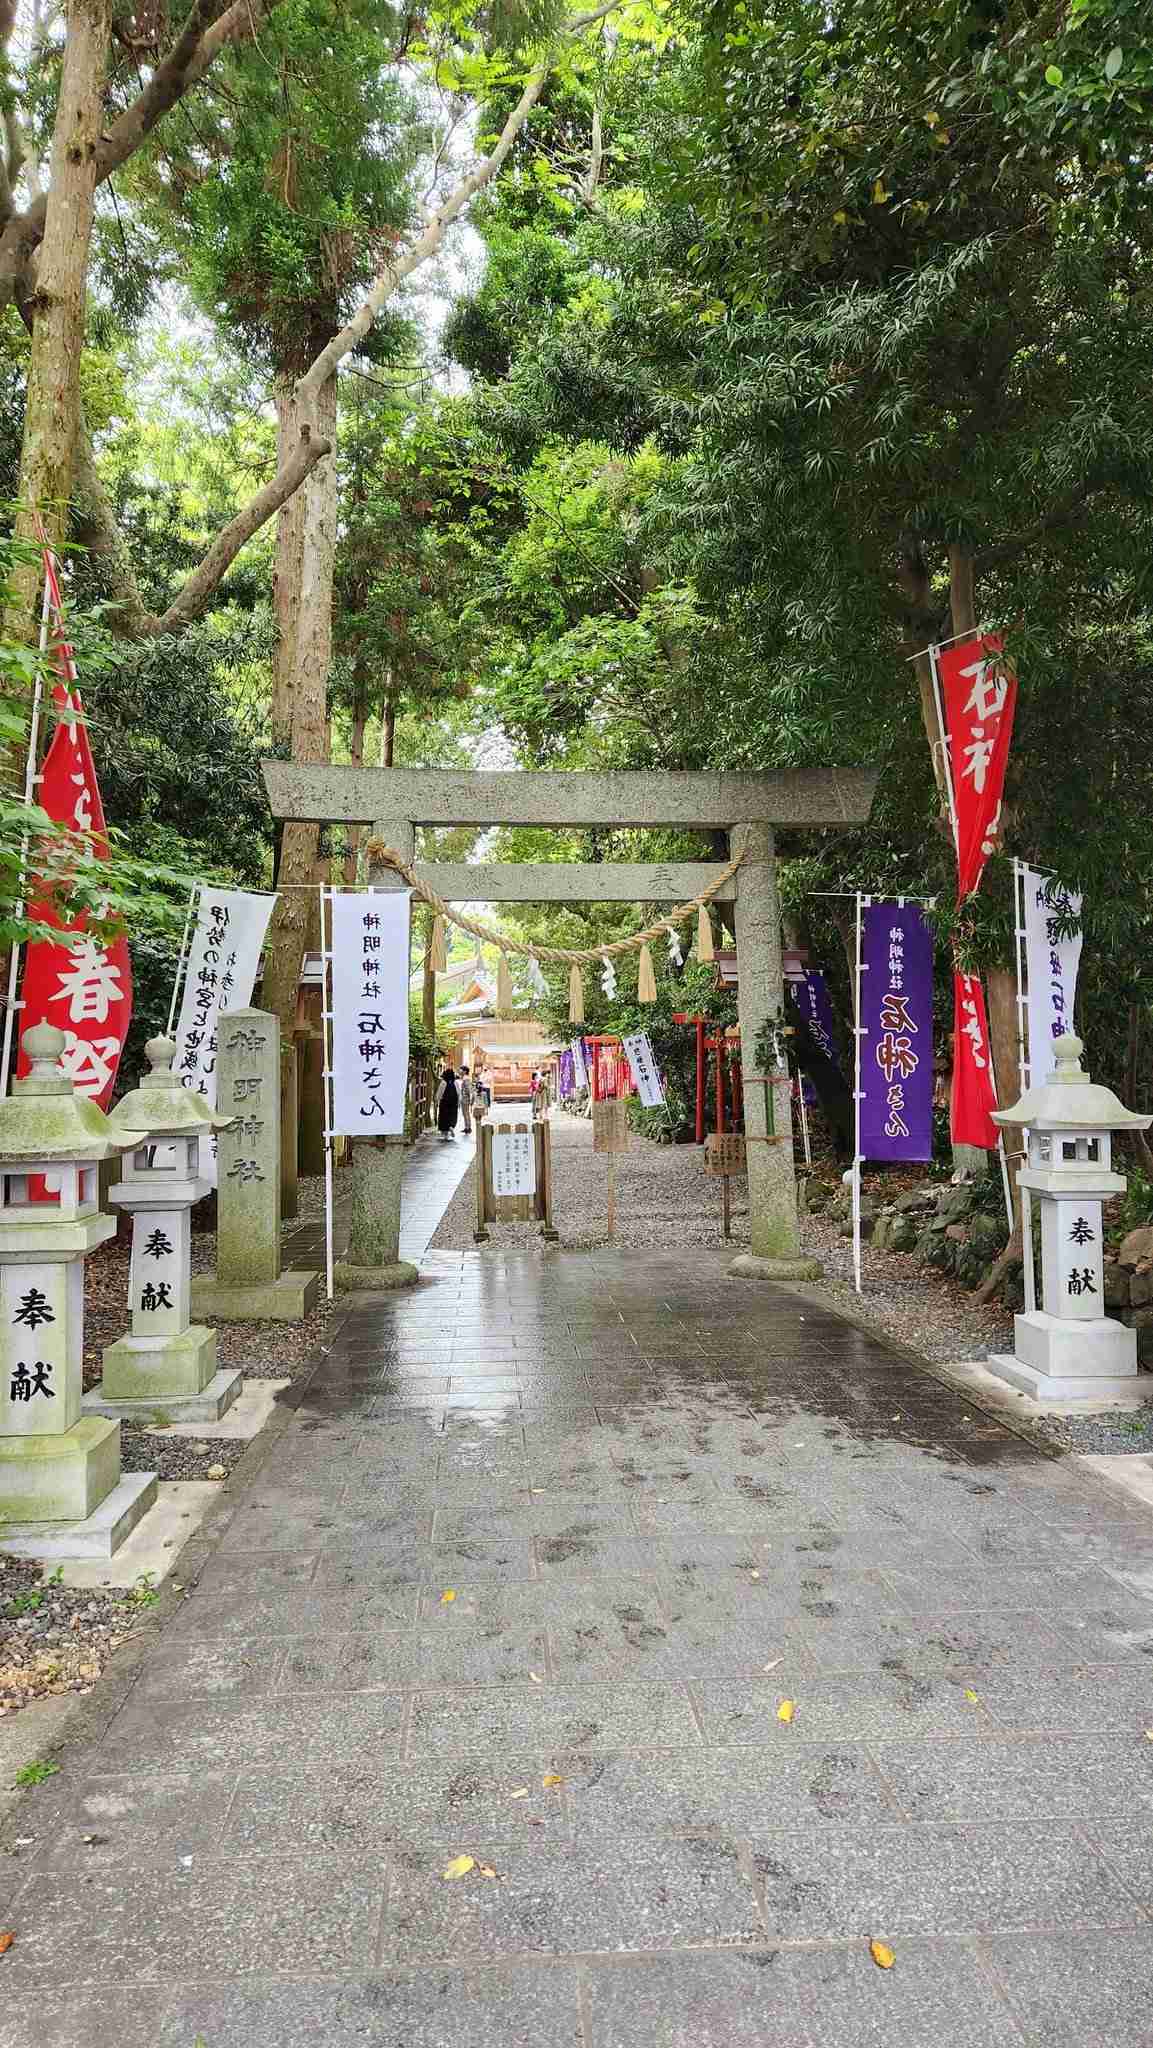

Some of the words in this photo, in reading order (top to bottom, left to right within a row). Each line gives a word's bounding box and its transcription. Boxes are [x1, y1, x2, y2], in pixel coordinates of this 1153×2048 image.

[226, 1029, 267, 1190] 神明神社
[141, 1228, 174, 1311] 奉献
[1067, 1217, 1097, 1296] 奉献
[10, 1288, 56, 1402] 奉献
